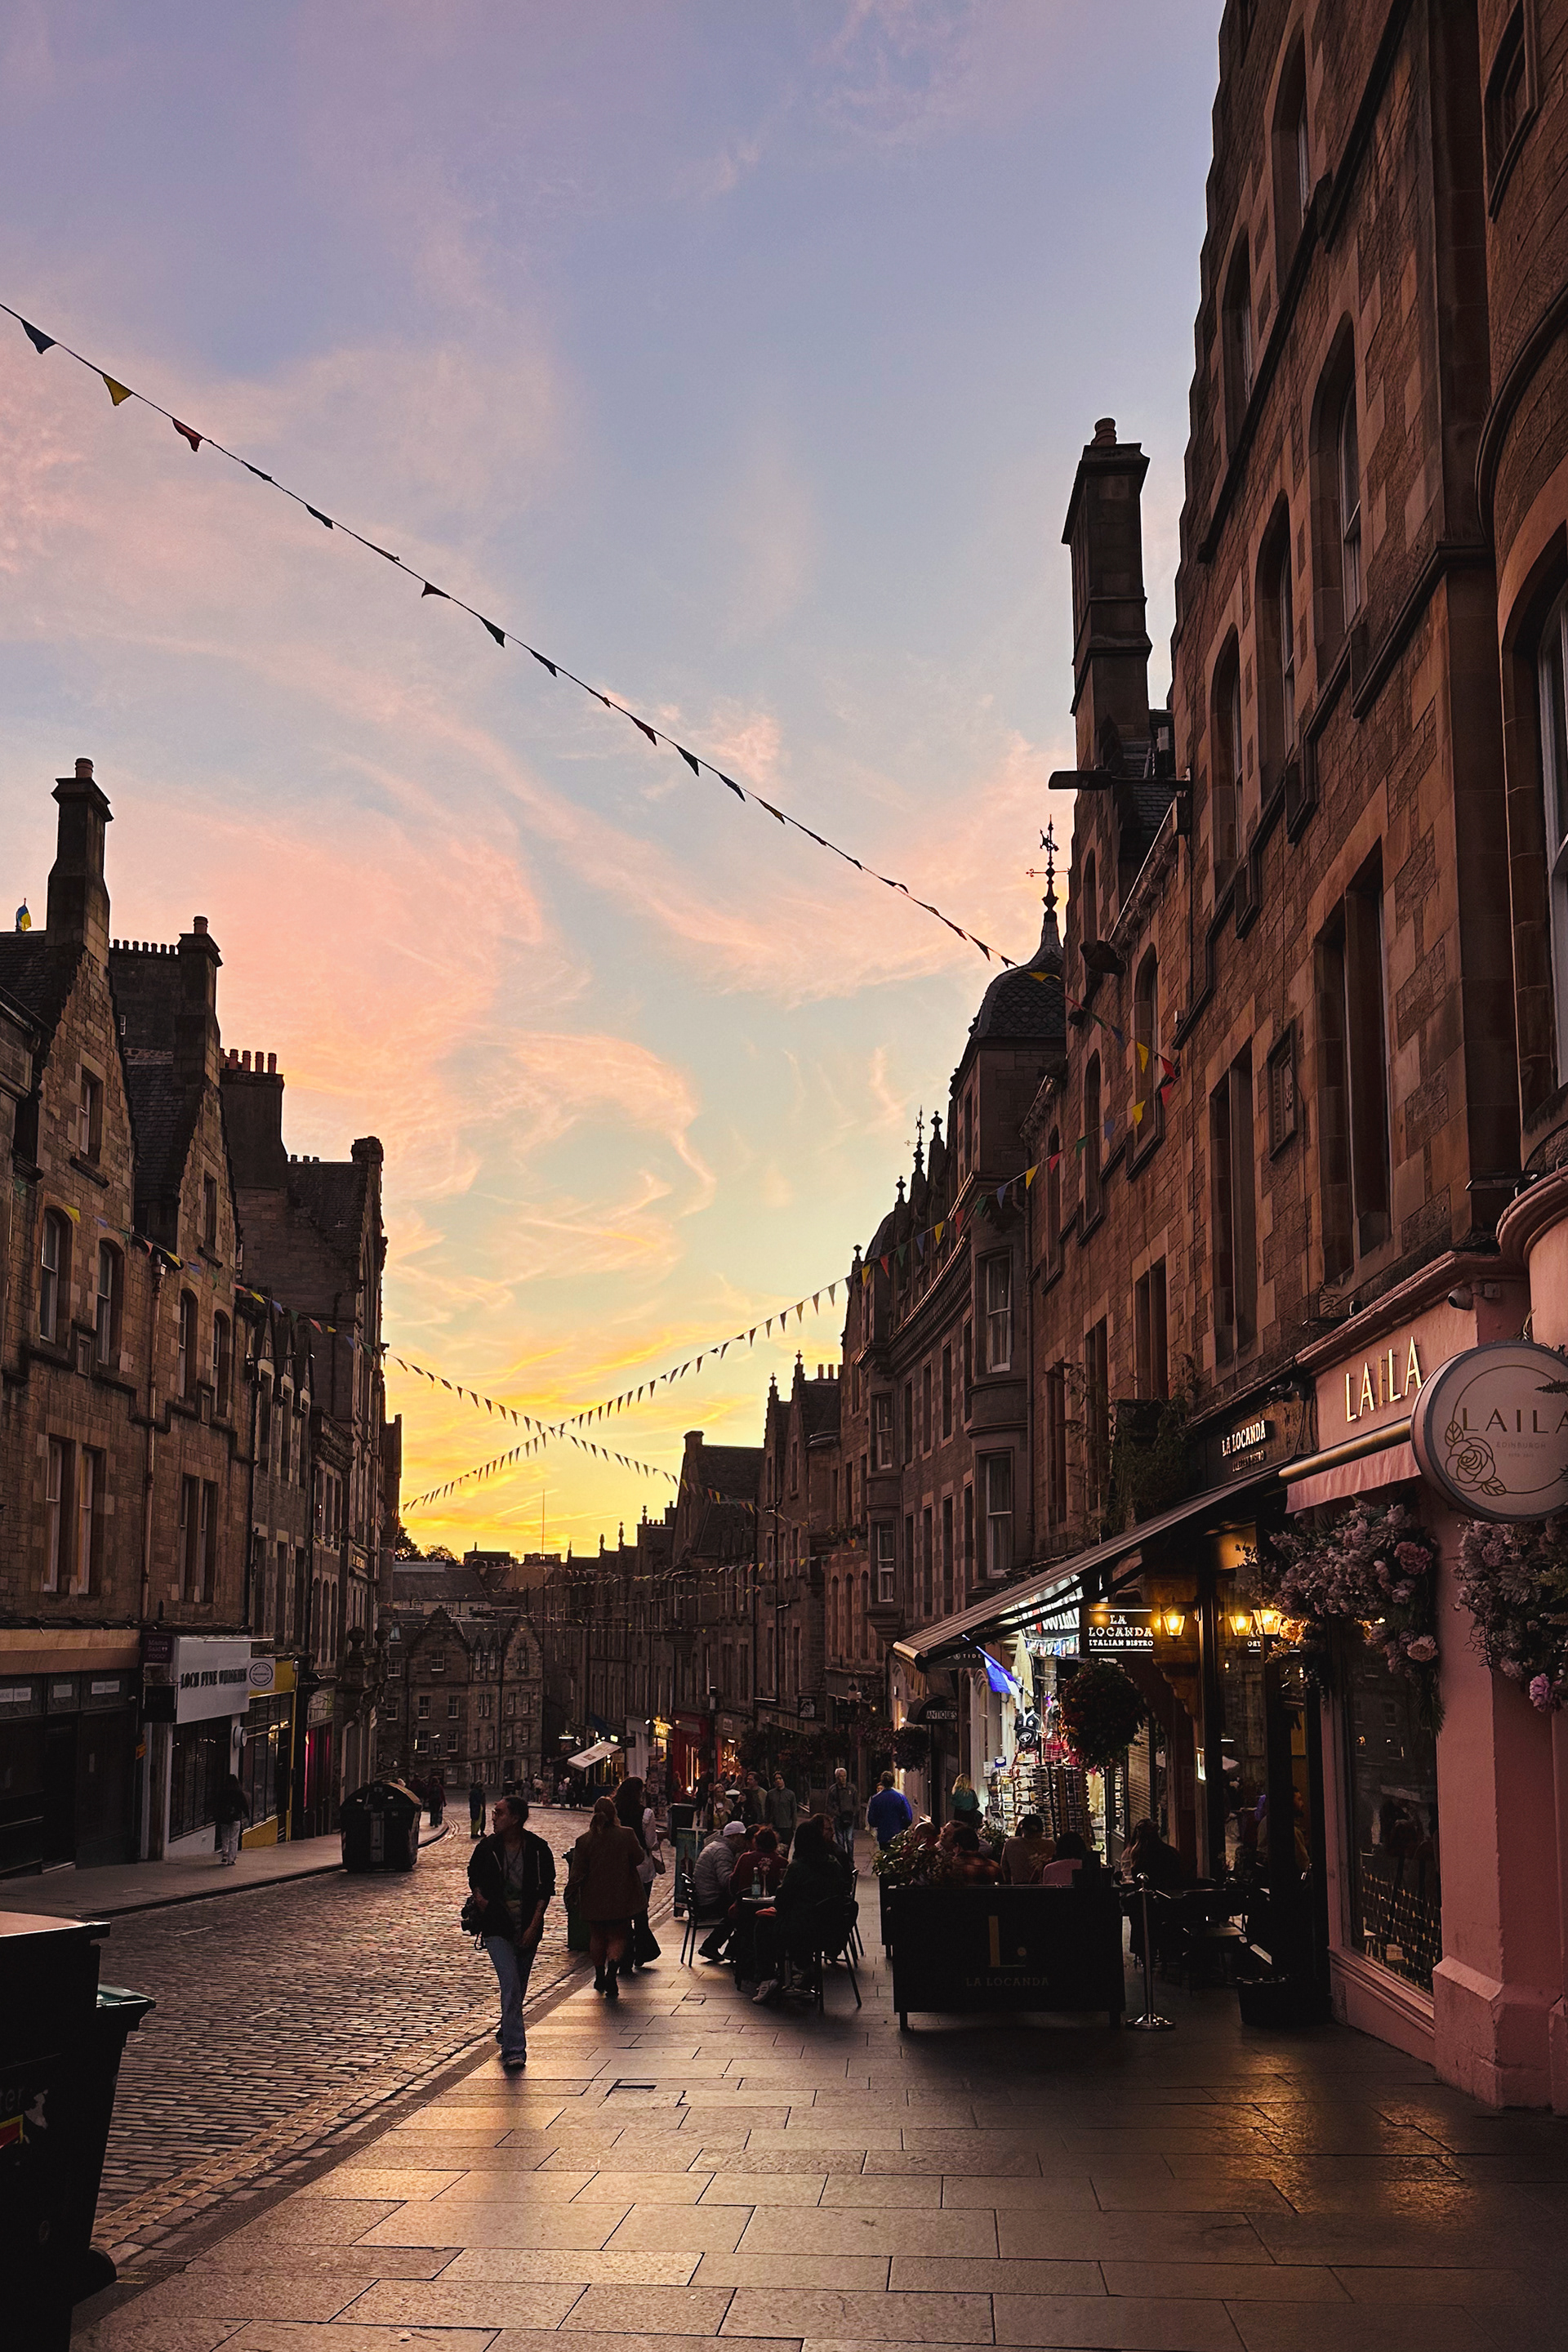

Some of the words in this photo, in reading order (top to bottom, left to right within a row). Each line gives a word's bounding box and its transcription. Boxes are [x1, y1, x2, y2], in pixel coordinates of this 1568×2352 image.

[1344, 1336, 1423, 1423] LAILA
[1222, 1436, 1232, 1458] LA
[1232, 1419, 1267, 1452] LOCANDA
[1496, 1441, 1547, 1450] EDINBURGH
[1110, 1615, 1127, 1624] LA
[1088, 1627, 1154, 1637] LOCANDA
[180, 1673, 199, 1689] LOCH
[927, 1710, 958, 1719] ANTIQUES
[966, 1977, 981, 1987] LA
[987, 1977, 1049, 1987] LOCANDA
